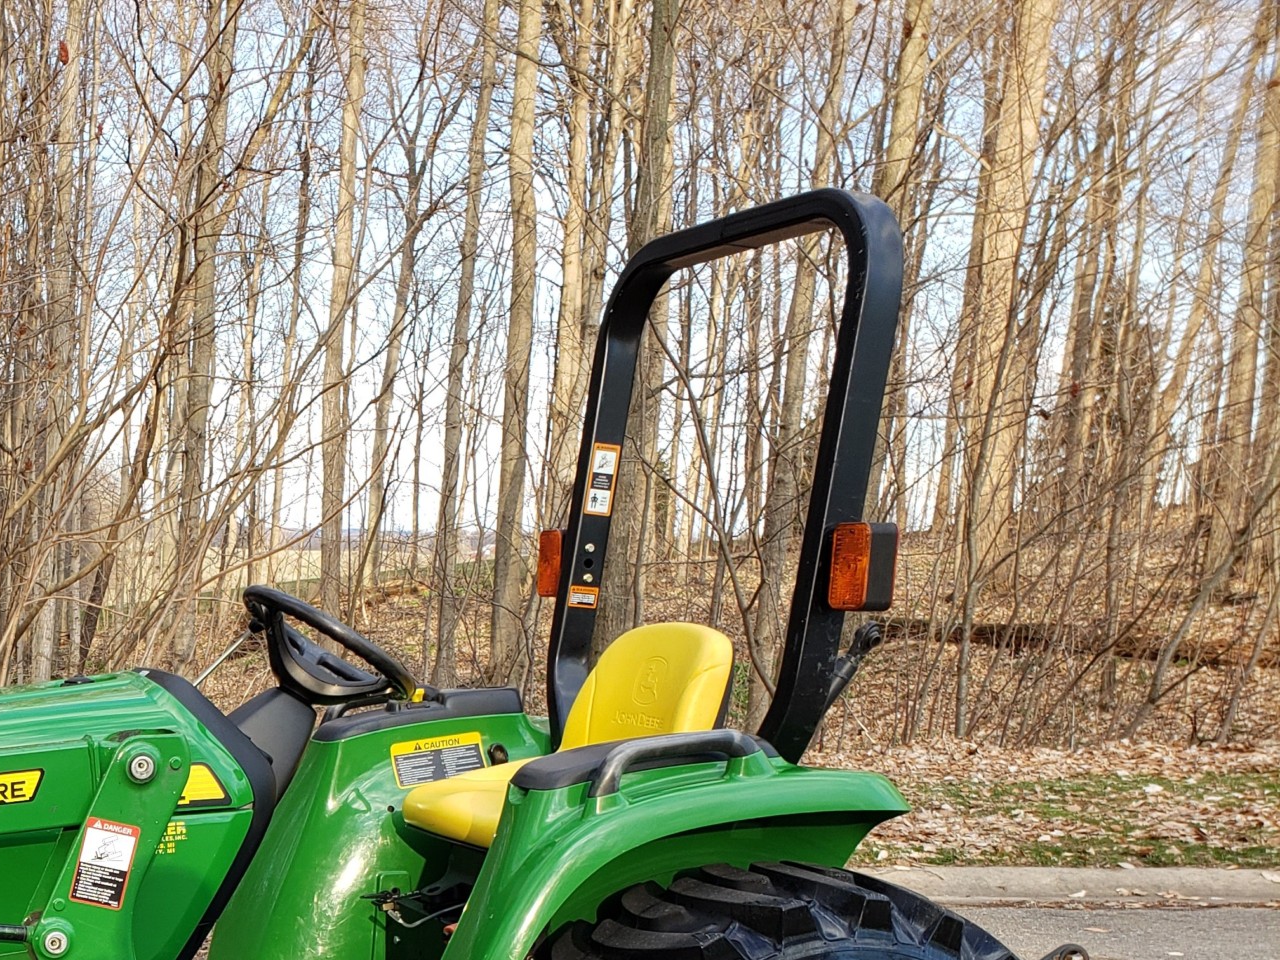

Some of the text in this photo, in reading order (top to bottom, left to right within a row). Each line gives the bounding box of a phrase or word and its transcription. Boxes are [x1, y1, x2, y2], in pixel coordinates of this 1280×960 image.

[611, 709, 638, 726] JOHN
[423, 738, 460, 750] CAUTION
[103, 824, 133, 835] DANGER
[163, 821, 187, 836] ER
